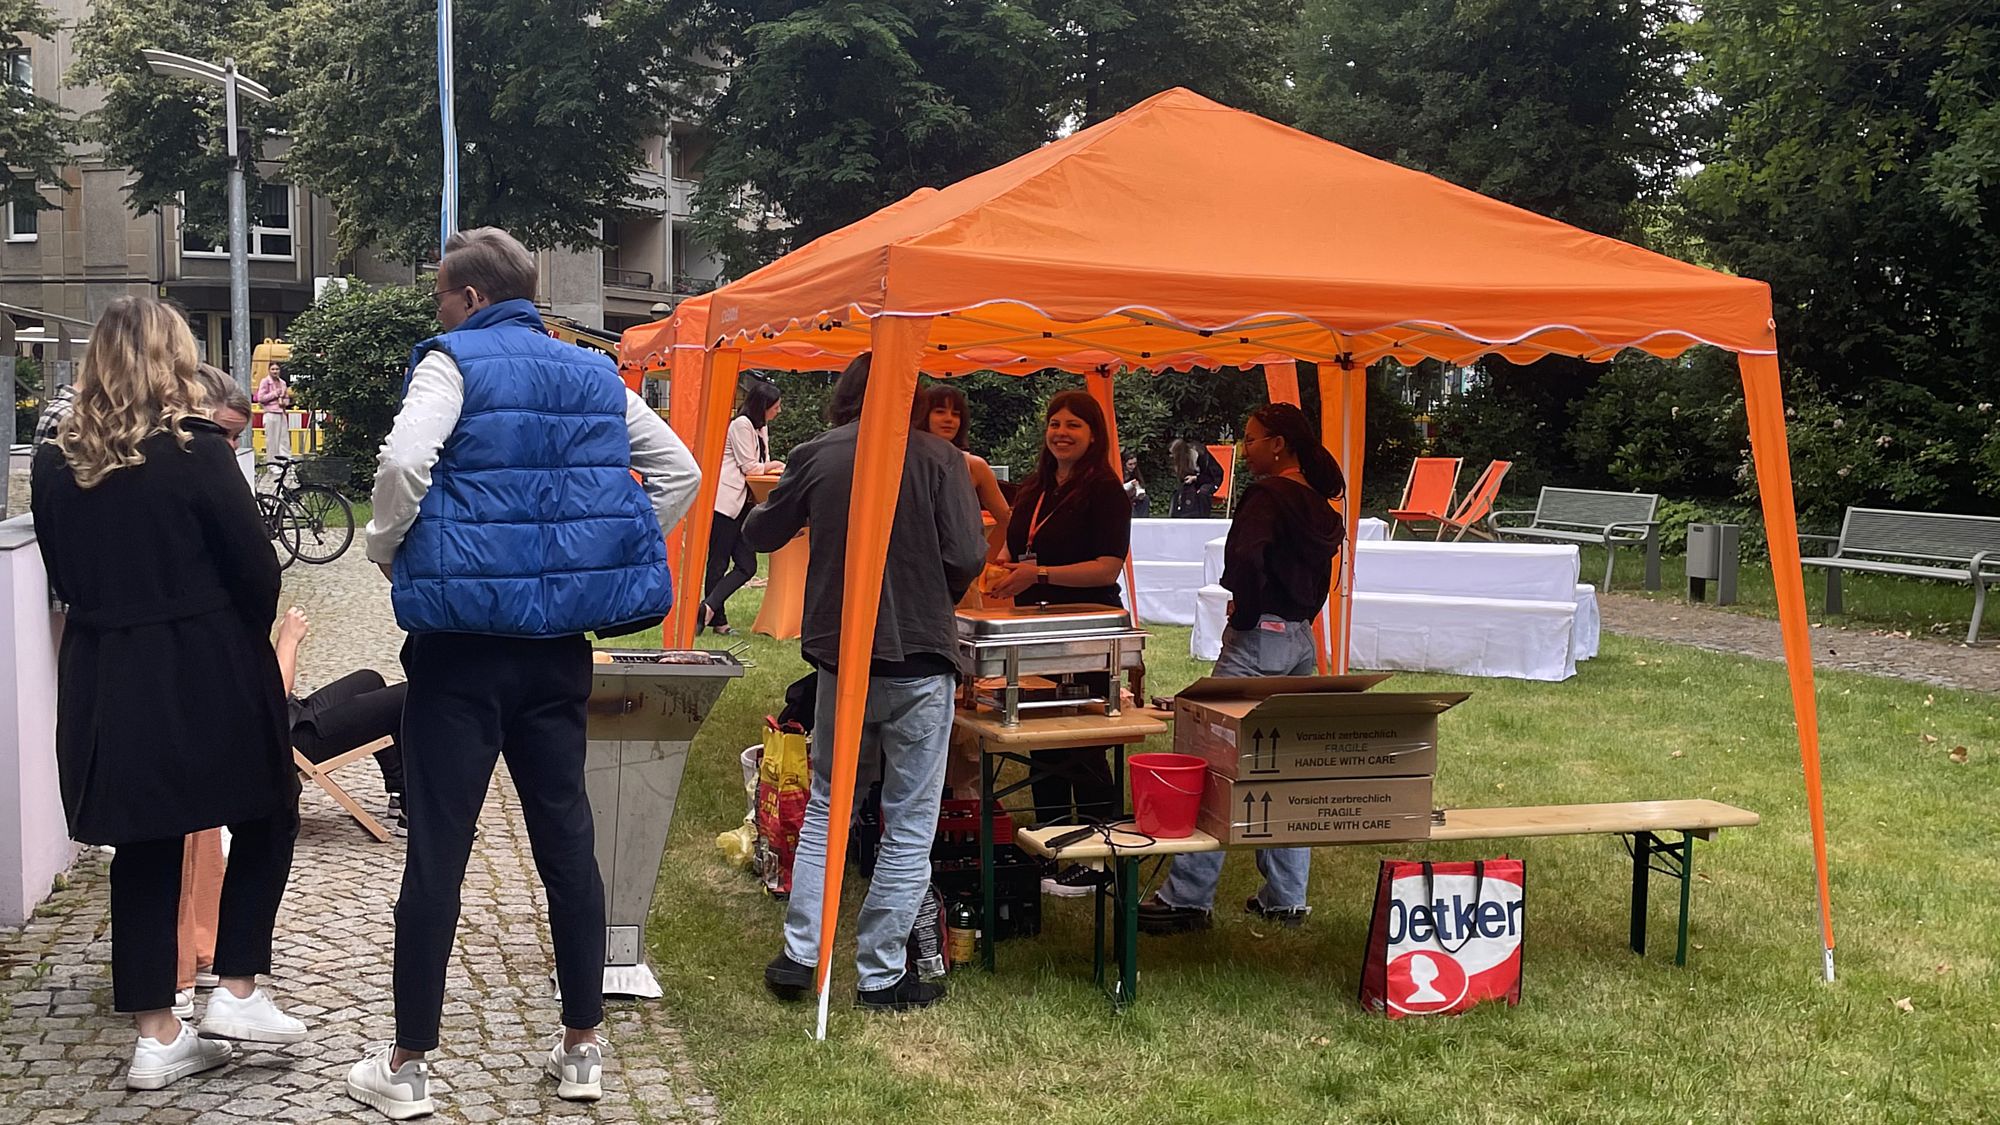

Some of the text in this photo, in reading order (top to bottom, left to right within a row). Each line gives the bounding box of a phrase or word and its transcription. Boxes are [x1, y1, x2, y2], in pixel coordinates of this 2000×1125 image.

[1296, 729, 1397, 740] Vorsicht zerbrechlich
[1325, 743, 1368, 752] FRAGILE
[1295, 755, 1396, 767] HANDLE WITH CARE
[1288, 793, 1392, 805] Vorsicht zerbrechlich
[1318, 808, 1361, 817] FRAGILE
[1287, 819, 1392, 831] HANDLE WITH CARE
